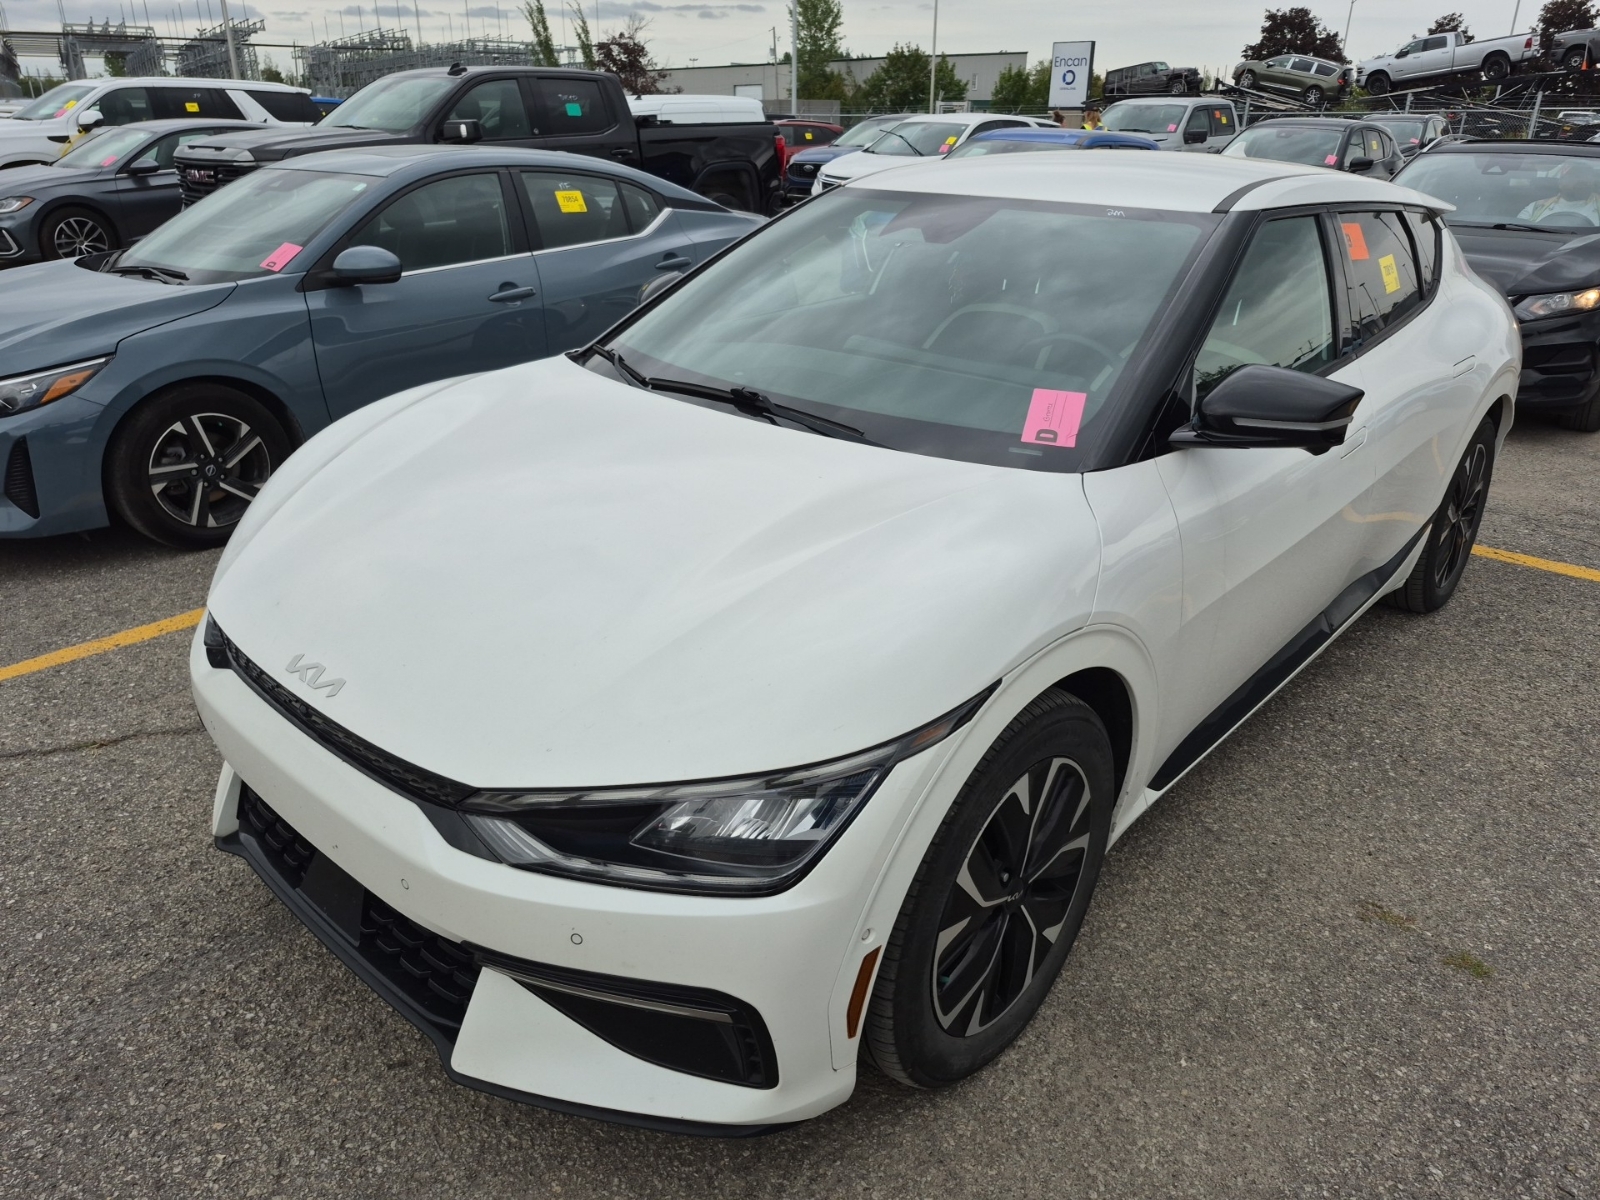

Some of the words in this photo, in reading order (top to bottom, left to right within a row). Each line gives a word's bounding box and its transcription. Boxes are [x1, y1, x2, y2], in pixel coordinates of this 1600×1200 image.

[1054, 56, 1088, 68] Encan
[186, 169, 214, 182] GMC
[1034, 428, 1058, 443] D
[285, 653, 347, 698] KIA
